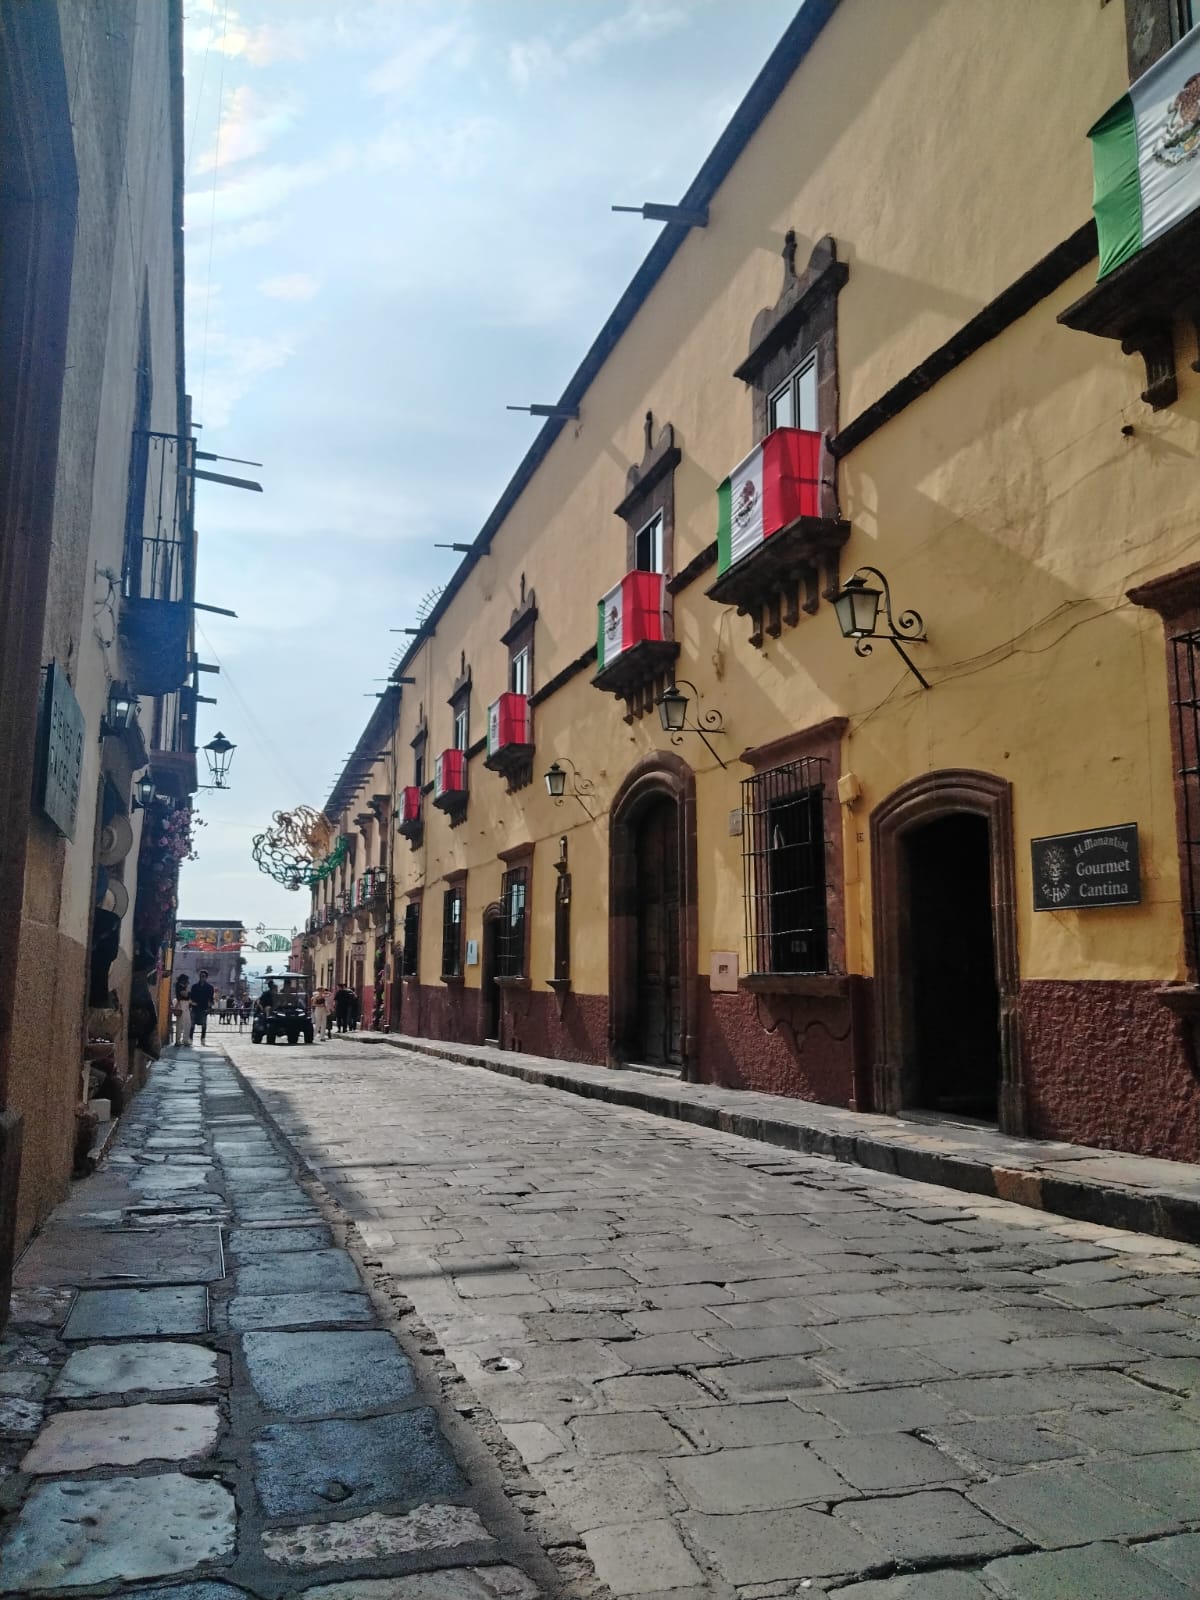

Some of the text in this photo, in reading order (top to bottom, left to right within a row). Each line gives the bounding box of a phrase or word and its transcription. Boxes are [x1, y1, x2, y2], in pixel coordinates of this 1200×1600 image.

[1073, 836, 1129, 857] El Manantial
[1076, 859, 1131, 876] Gourmet
[1079, 880, 1129, 897] Cantina
